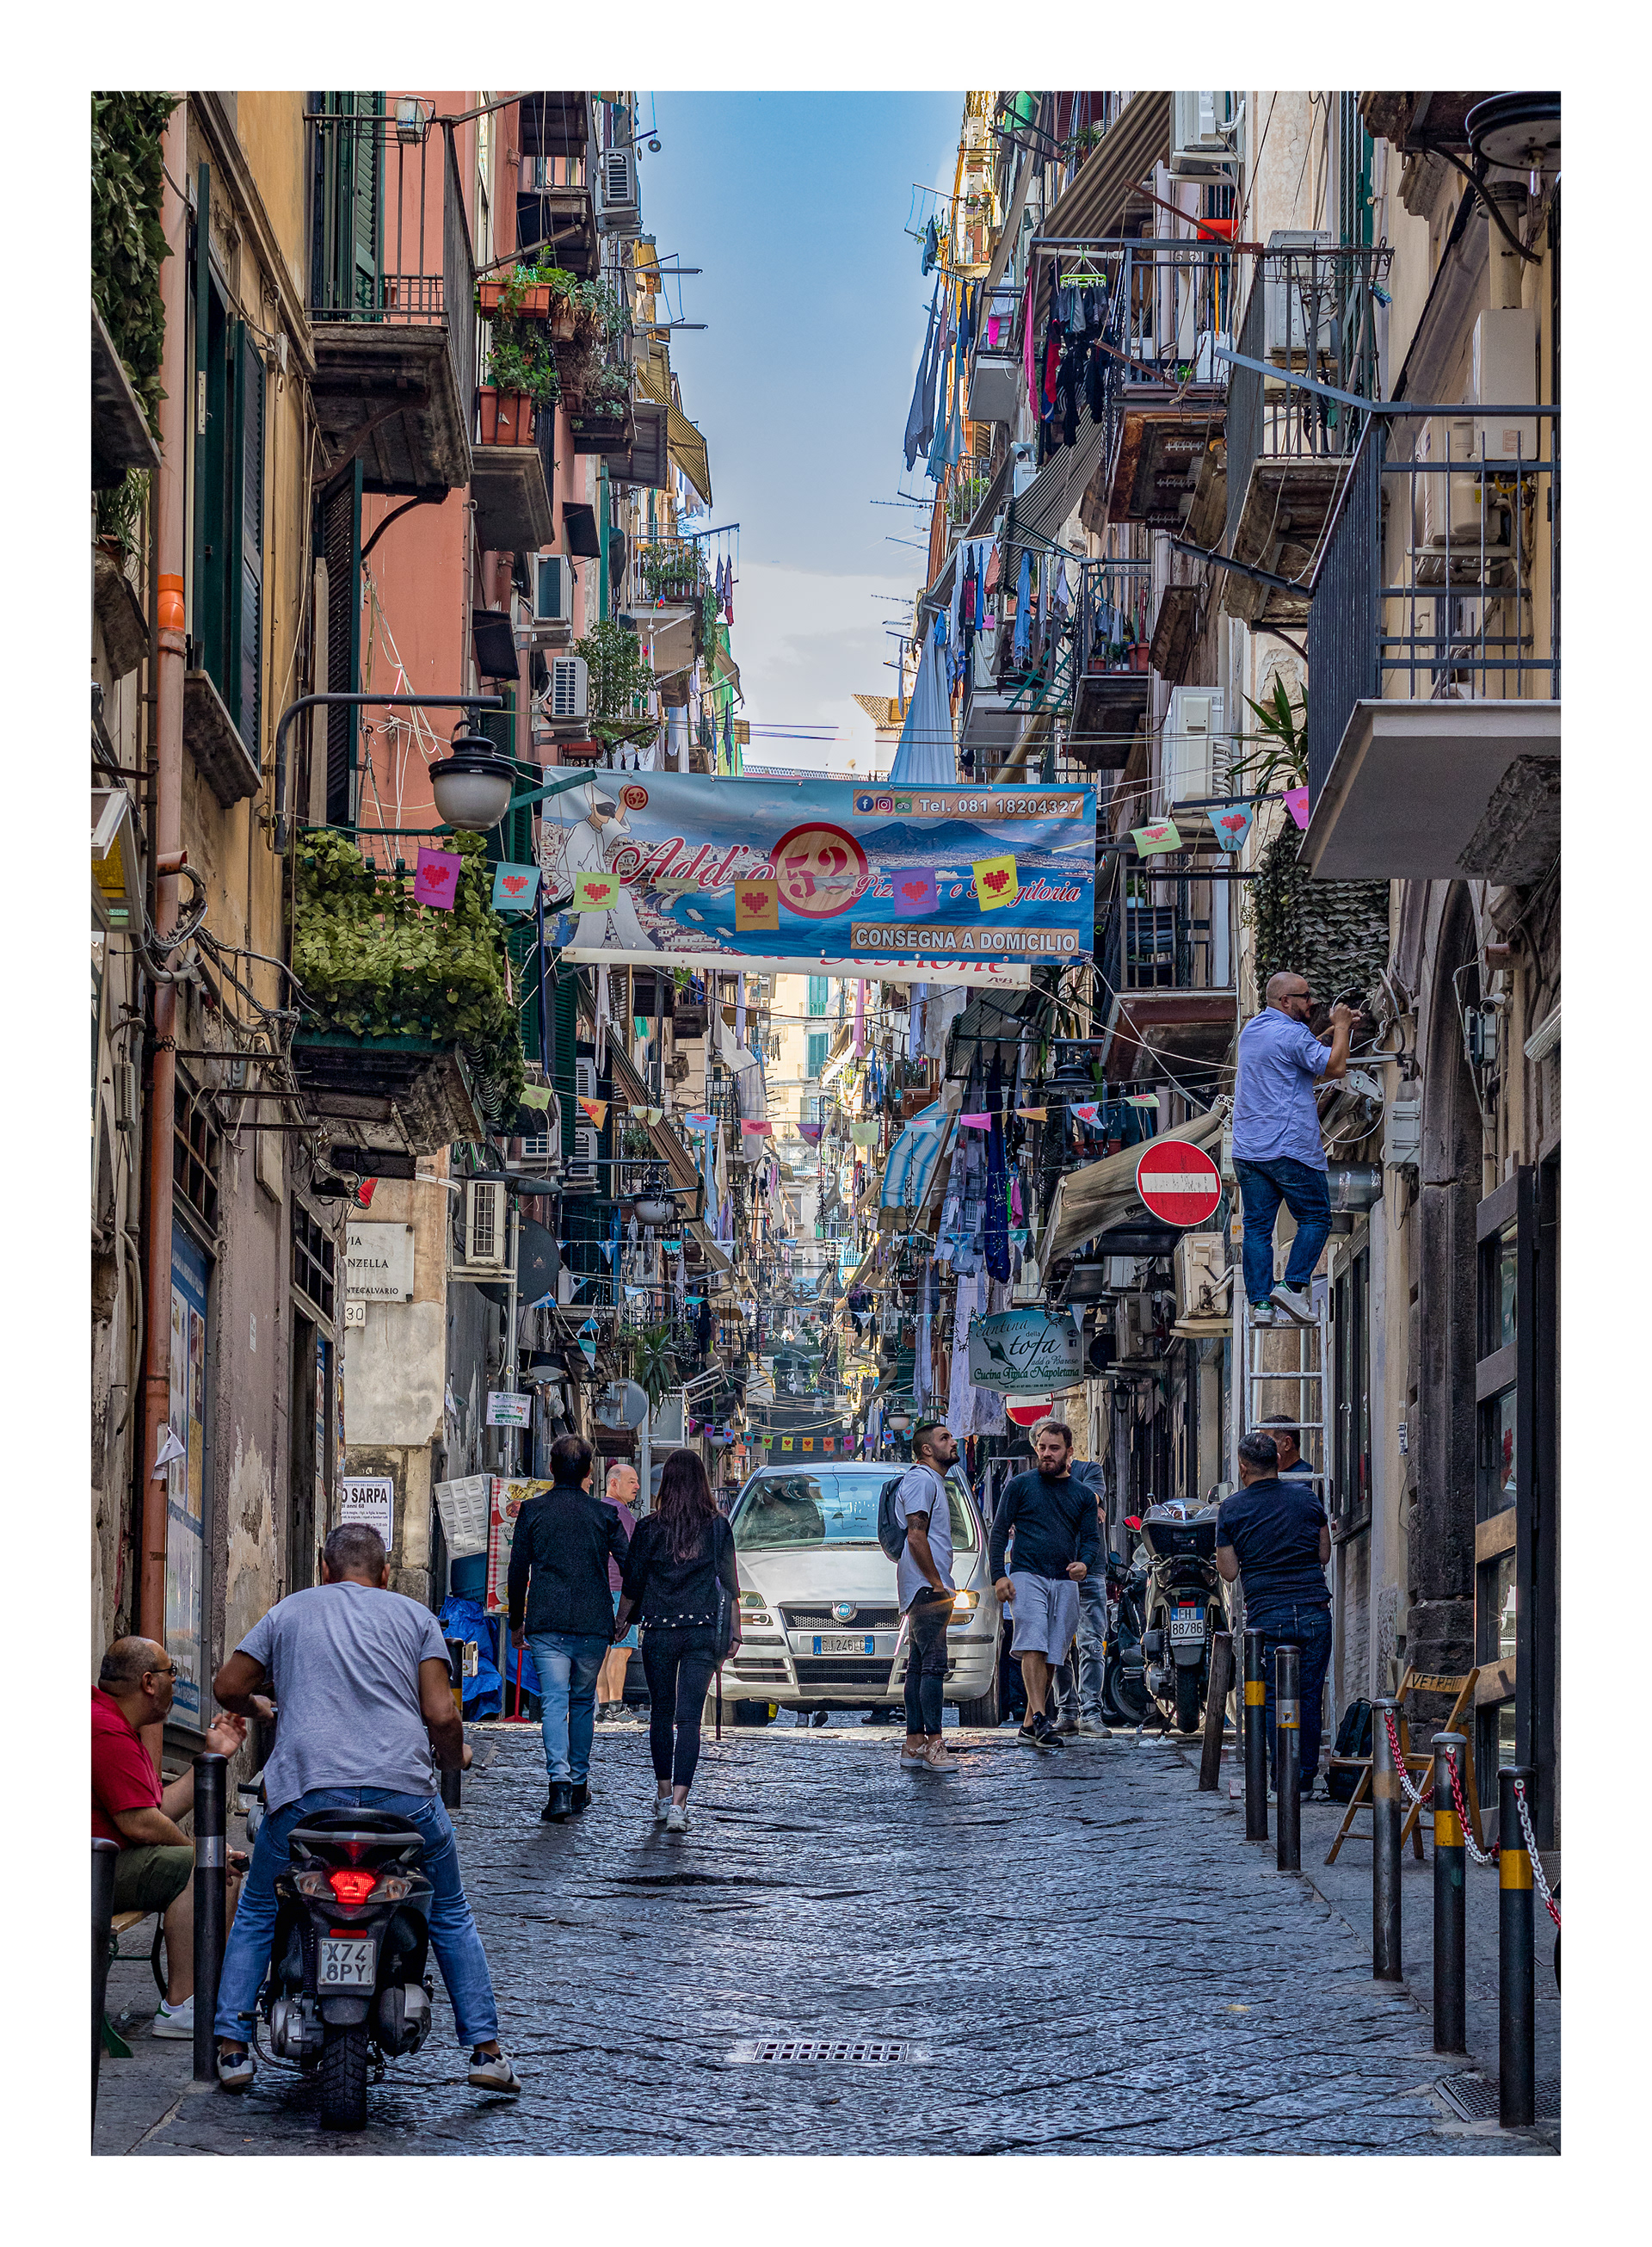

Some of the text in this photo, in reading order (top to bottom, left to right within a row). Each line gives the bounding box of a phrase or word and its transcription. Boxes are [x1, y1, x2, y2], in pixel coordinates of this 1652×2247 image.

[627, 791, 645, 804] 52
[919, 799, 1080, 814] Tel. 081 18204327
[784, 846, 854, 899] 52
[950, 884, 963, 898] e
[855, 929, 1076, 952] CONSEGNA A DOMICILIO
[348, 1258, 389, 1269] NZELLA
[346, 1307, 364, 1320] 30
[976, 1318, 1031, 1338] cantina
[974, 1367, 1002, 1380] Cucina
[1030, 1365, 1080, 1381] Napoletana
[351, 1487, 388, 1503] SARPA
[1172, 1622, 1203, 1635] 88786
[326, 1943, 367, 1962] X74
[326, 1962, 367, 1982] 8PY
